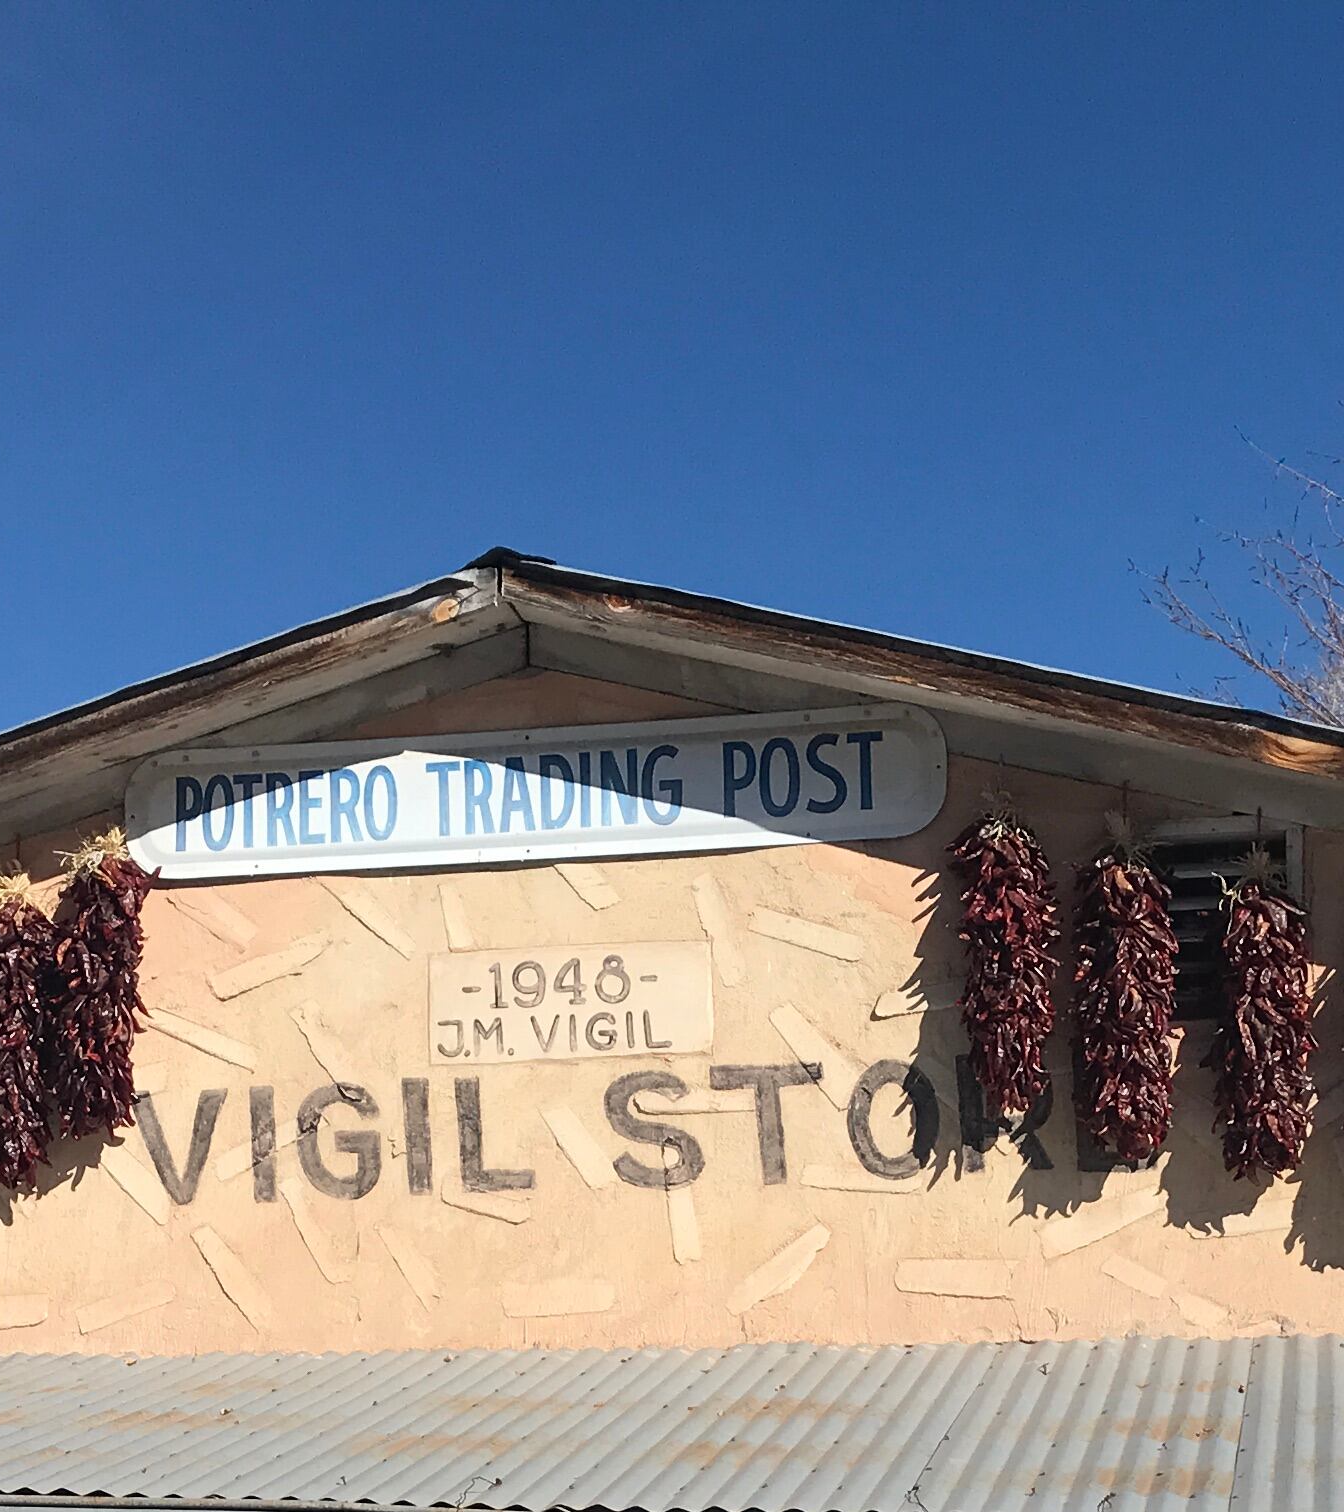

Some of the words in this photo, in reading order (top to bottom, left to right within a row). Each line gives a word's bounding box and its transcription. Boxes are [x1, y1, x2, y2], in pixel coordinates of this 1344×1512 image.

[174, 764, 399, 853] POTRERO
[426, 743, 684, 837] TRADING
[721, 731, 885, 819] POST
[530, 1010, 673, 1052] VIGIL
[133, 1076, 537, 1206] VIGIL
